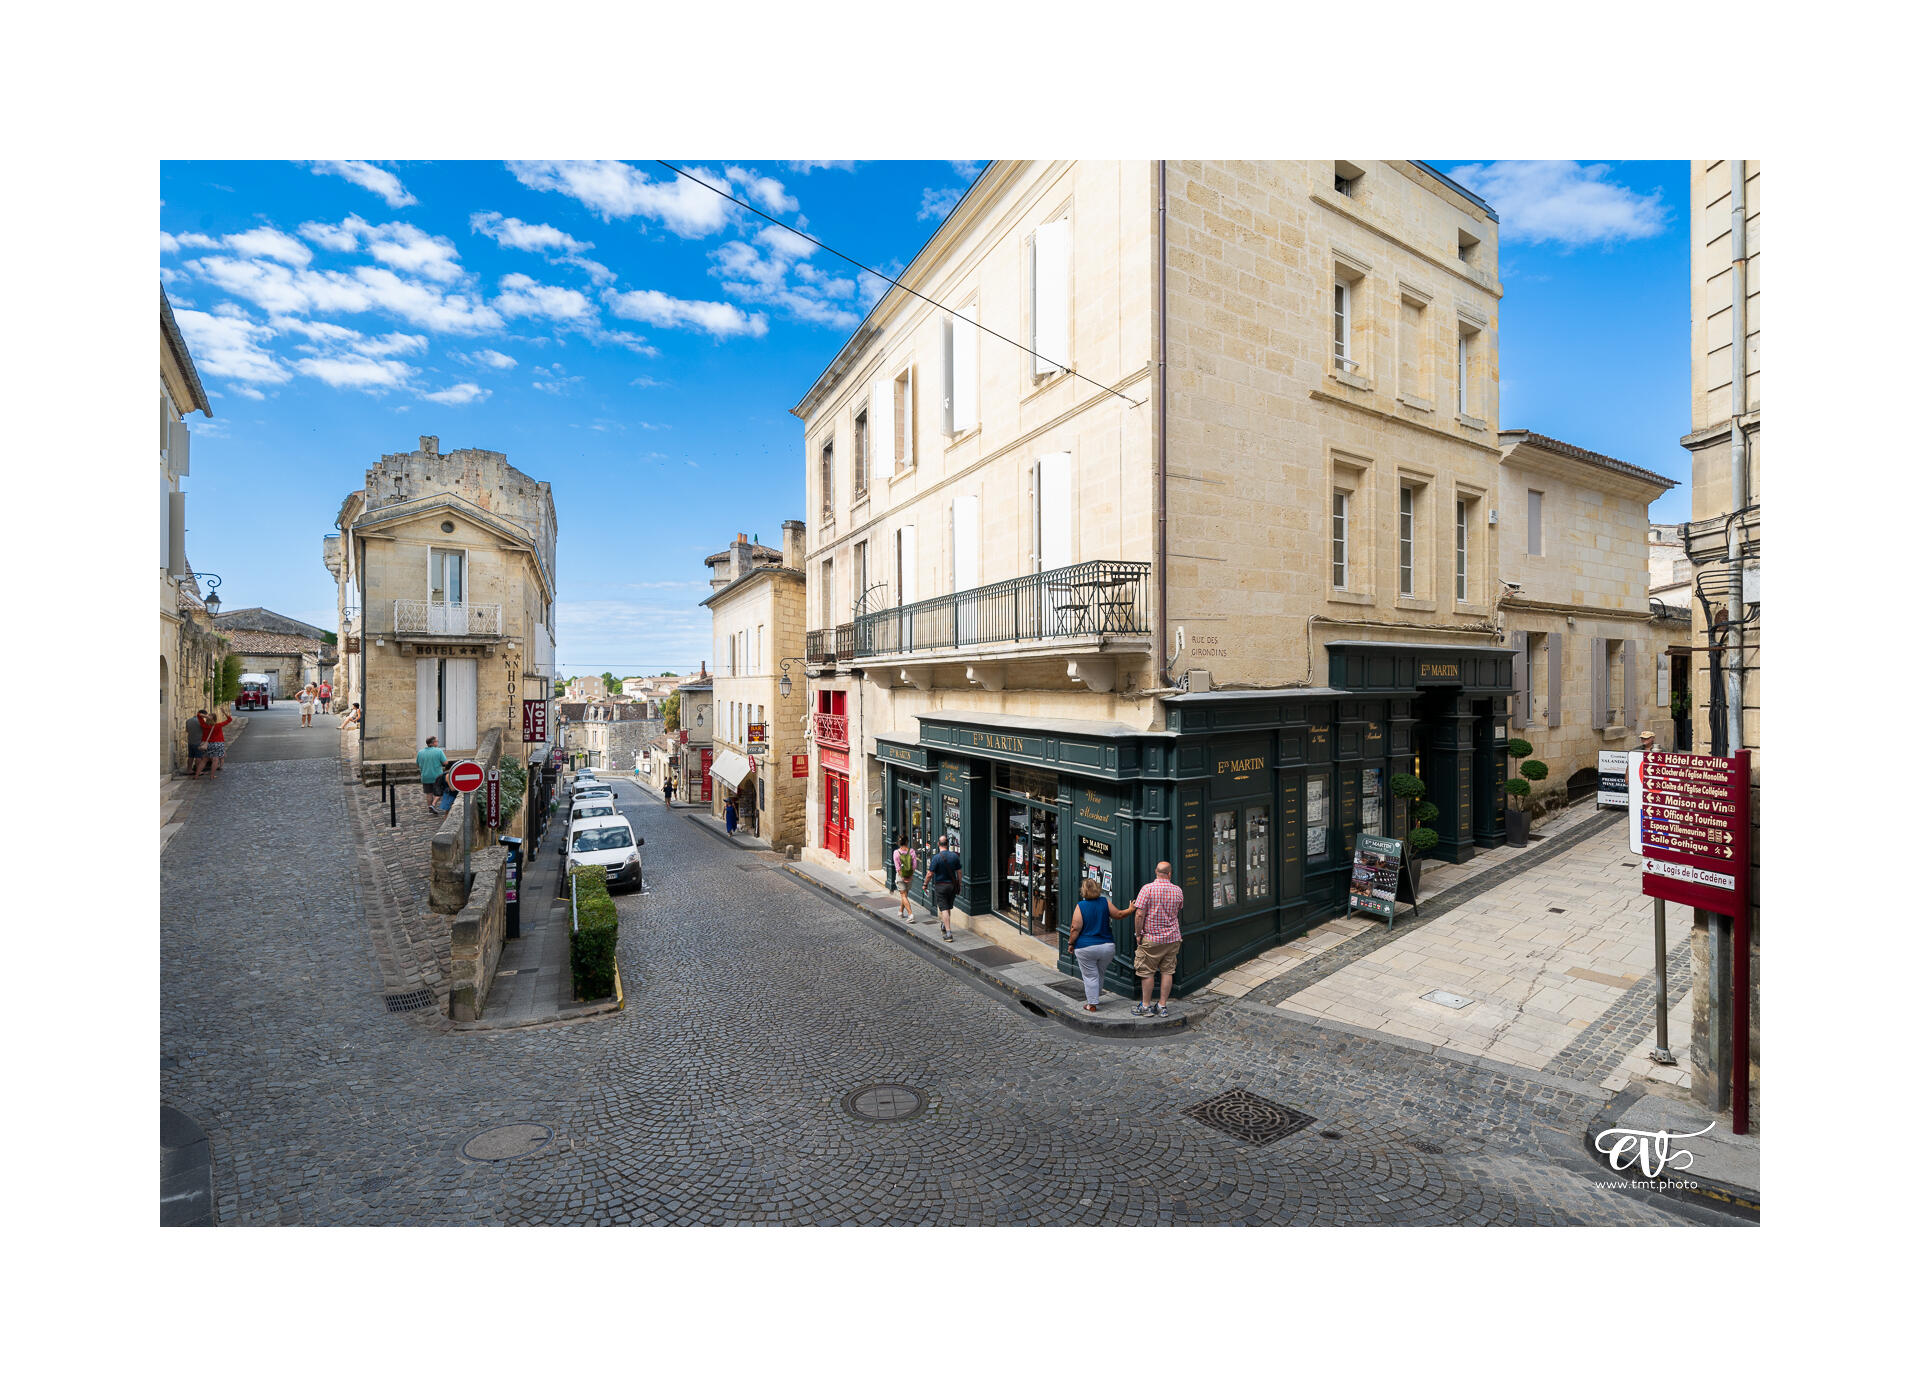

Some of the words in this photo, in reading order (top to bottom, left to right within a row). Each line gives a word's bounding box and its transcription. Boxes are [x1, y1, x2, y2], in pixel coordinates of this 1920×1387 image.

[1191, 636, 1205, 644] RUE
[1206, 636, 1219, 645] DES
[416, 646, 456, 656] HOTEL
[1191, 648, 1228, 657] GIRONDINS
[1431, 664, 1459, 677] MARTIN
[507, 670, 516, 731] HOTEL
[534, 702, 546, 741] HOTEL
[986, 734, 1024, 753] MARTIN
[1231, 757, 1265, 772] MARTIN
[1665, 754, 1690, 766] Hôtel
[1691, 757, 1704, 767] de
[1705, 758, 1729, 769] ville
[1661, 767, 1678, 777] Clocher
[1678, 769, 1685, 778] de
[1677, 783, 1684, 791] de
[1702, 787, 1729, 797] Collégiale
[1664, 796, 1697, 808] Maison
[1698, 800, 1710, 809] du
[1711, 801, 1728, 813] Vin
[1663, 809, 1684, 821] Office
[1684, 812, 1693, 821] de
[1694, 813, 1728, 828] Tourisme
[1650, 821, 1669, 832] Espace
[1669, 824, 1706, 838] Villemaurine
[1090, 840, 1109, 852] MARTIN
[1650, 834, 1670, 845] Salle
[1670, 837, 1709, 852] Gothique
[1663, 863, 1681, 876] Logis
[1682, 868, 1690, 877] de
[1691, 869, 1699, 878] la
[1700, 871, 1728, 885] Cadène
